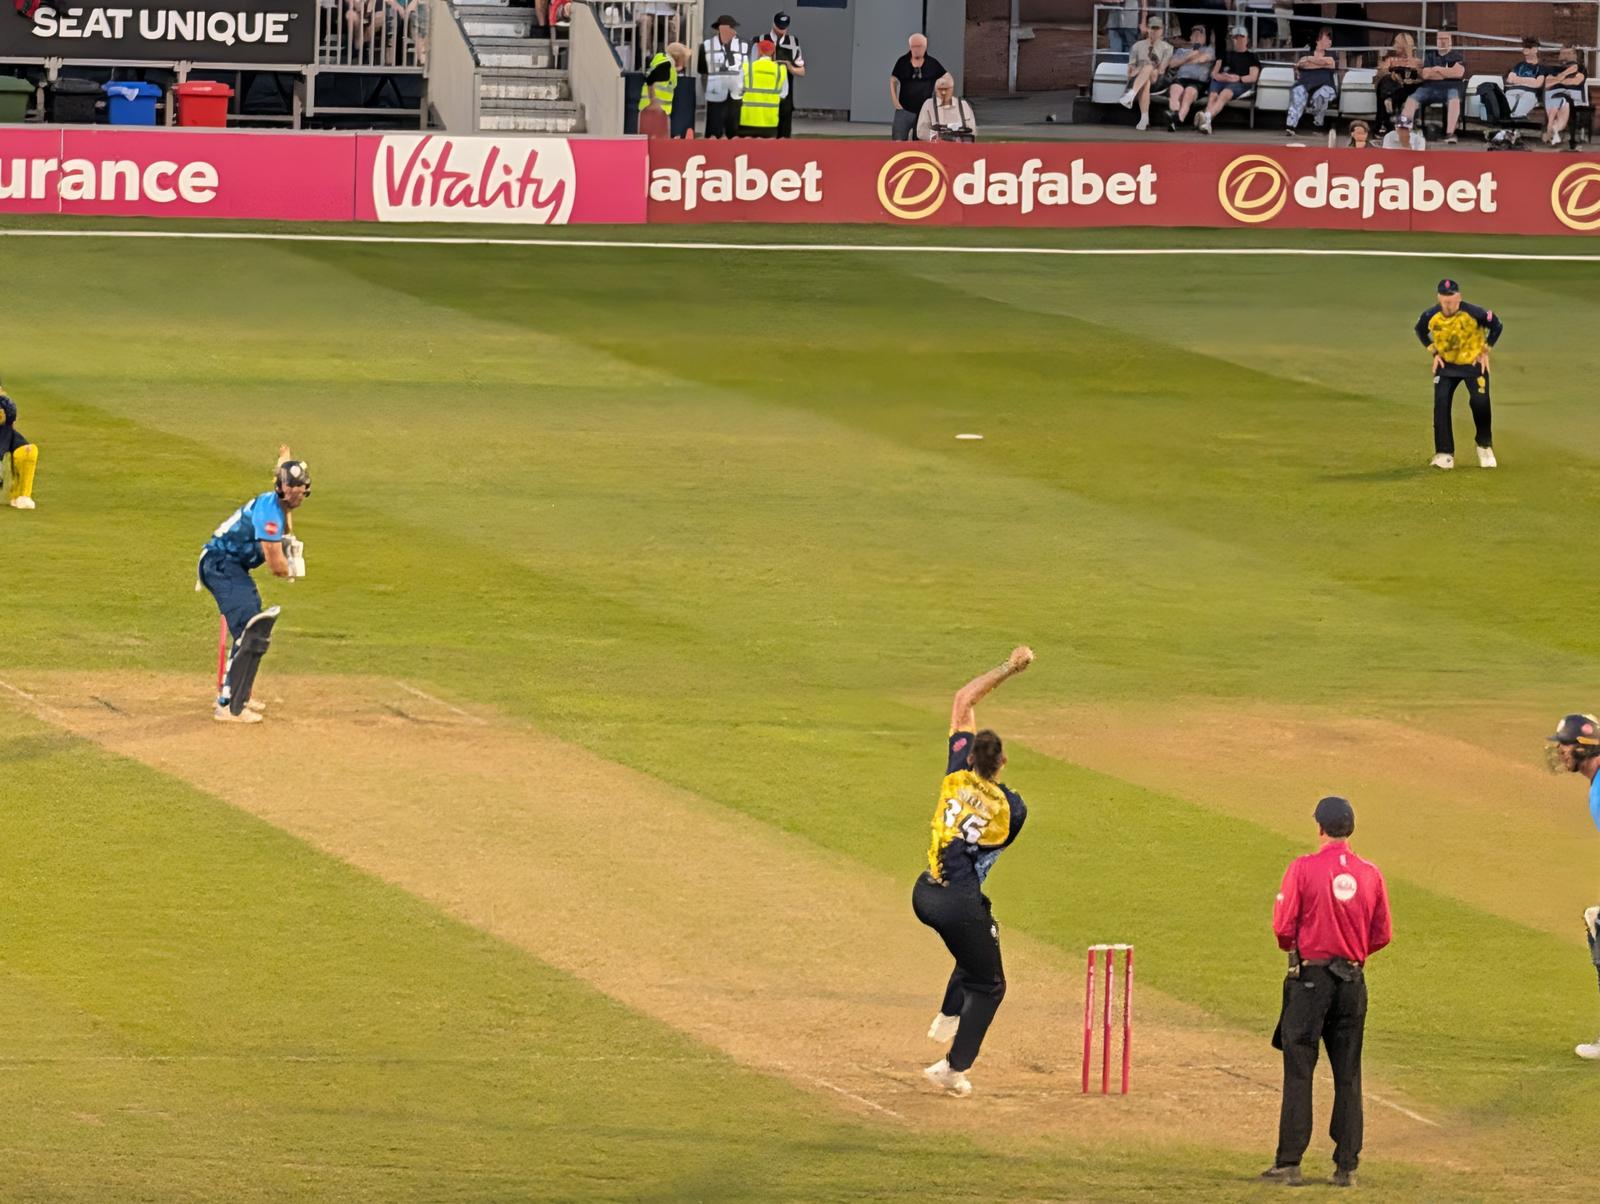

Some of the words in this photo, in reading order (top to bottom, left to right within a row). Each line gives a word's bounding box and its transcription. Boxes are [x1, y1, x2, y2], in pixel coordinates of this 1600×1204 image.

[32, 6, 132, 38] SEAT
[139, 8, 290, 46] UNIQUE
[0, 158, 219, 203] urance
[385, 135, 566, 224] Vitality
[645, 153, 823, 211] afabet
[953, 158, 1157, 214] dafabet
[1293, 161, 1497, 219] dafabet
